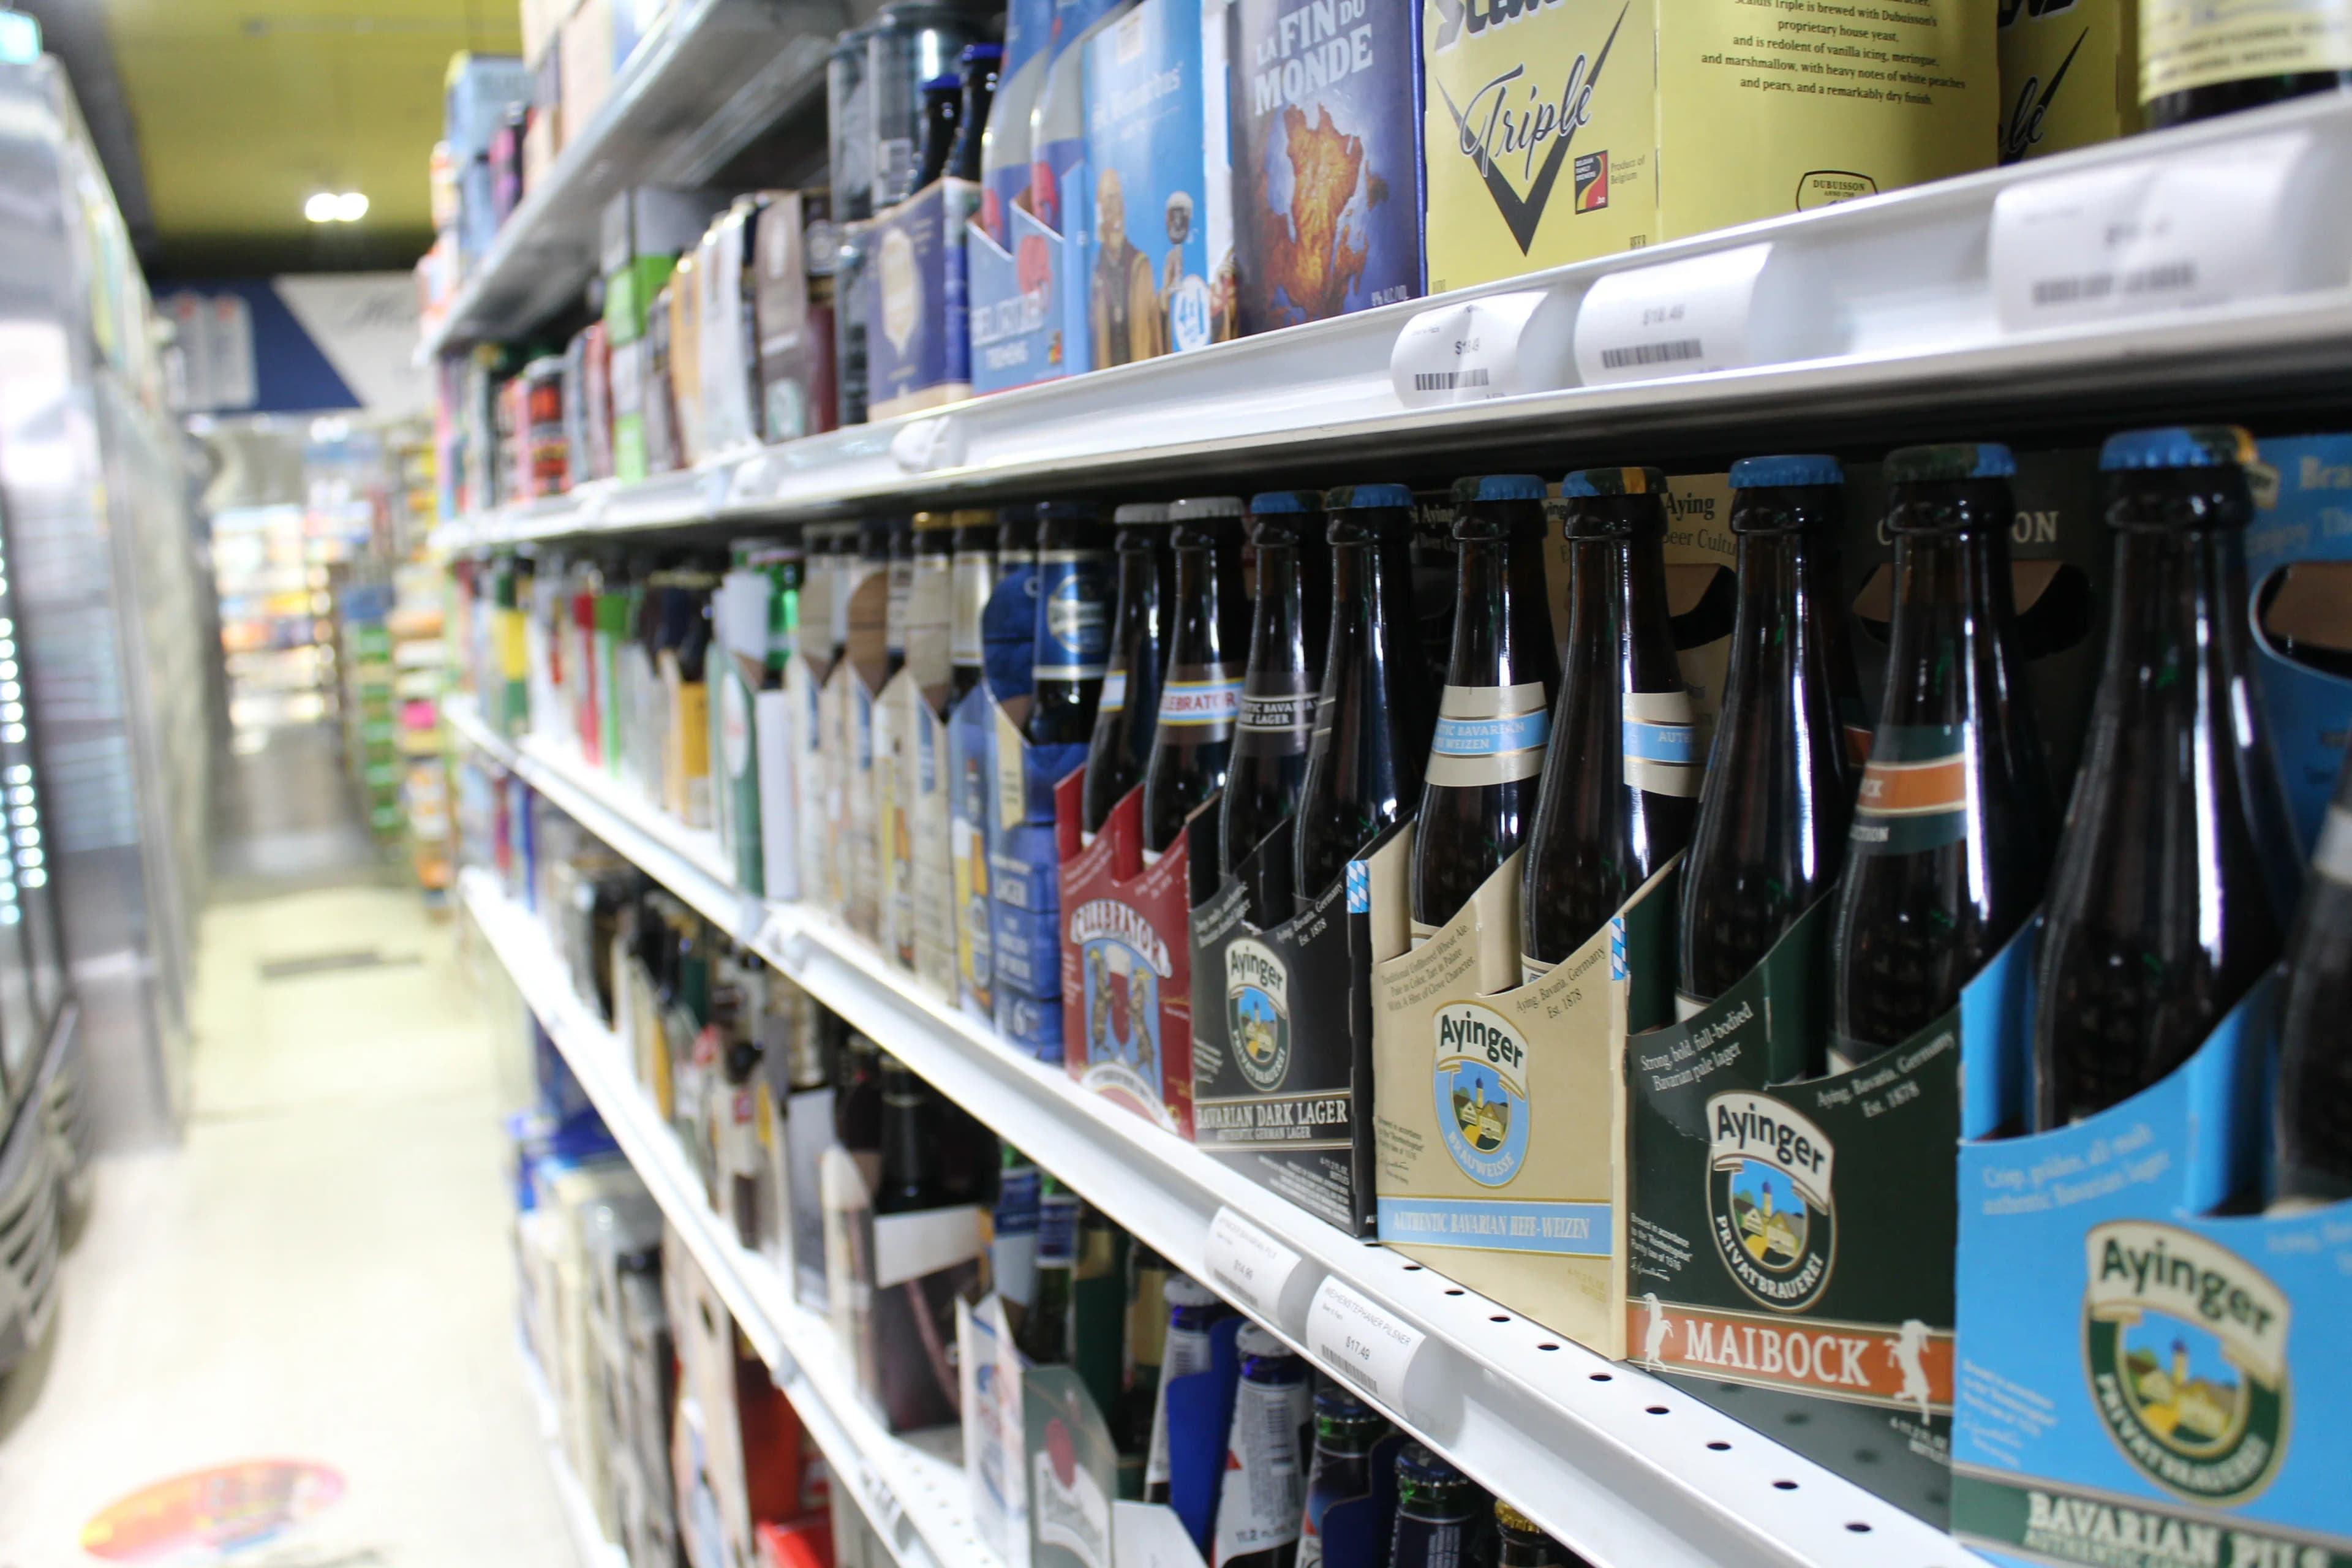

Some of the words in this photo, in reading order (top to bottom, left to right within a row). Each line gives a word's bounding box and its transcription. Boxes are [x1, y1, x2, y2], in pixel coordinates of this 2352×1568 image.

[1776, 0, 1804, 12] Triple
[1807, 2, 1815, 12] is
[1817, 2, 1855, 17] brewed
[1858, 8, 1880, 20] with
[1882, 10, 1937, 28] Dubuisson's
[1777, 20, 1836, 37] proprietary
[1839, 25, 1868, 38] house
[1256, 37, 1277, 66] LA
[1278, 0, 1343, 58] FIN
[1339, 0, 1365, 26] DU
[1733, 36, 1753, 47] and
[1756, 37, 1764, 48] is
[1767, 39, 1811, 53] redolent
[1814, 43, 1825, 54] of
[1827, 46, 1860, 58] vanilla
[1863, 48, 1889, 62] icing,
[1892, 53, 1939, 67] meringue,
[1255, 23, 1373, 117] MONDE
[1702, 53, 1722, 64] and
[1725, 56, 1798, 72] marshmallow,
[1801, 61, 1823, 74] with
[1826, 64, 1855, 80] heavy
[1858, 69, 1885, 80] notes
[1887, 70, 1898, 81] of
[1900, 72, 1926, 85] white
[1929, 77, 1966, 89] peaches
[1740, 78, 1760, 88] and
[1763, 80, 1794, 92] pears,
[1797, 83, 1816, 94] and
[1827, 86, 1883, 103] remarkably
[1887, 91, 1902, 104] dry
[1460, 53, 1591, 181] Triple
[1610, 160, 1636, 172] Product
[1637, 154, 1646, 165] of
[1610, 172, 1638, 185] Belgium
[1812, 179, 1866, 192] DUBUISSON
[1666, 492, 1715, 521] Aying
[1697, 529, 1737, 556] Cultu
[1256, 714, 1290, 725] LAGER
[1457, 722, 1525, 736] BAVARIAN
[1446, 739, 1490, 750] WEIZEN
[1314, 881, 1343, 913] Germany
[1231, 946, 1283, 992] Ayinger
[1567, 945, 1606, 981] Germany
[1547, 1005, 1562, 1019] Est.
[1561, 987, 1583, 1010] 1878
[1440, 1011, 1524, 1069] Ayinger
[1640, 1054, 1679, 1072] Strong,
[1669, 1039, 1697, 1063] bold,
[1693, 1000, 1754, 1051] full-bodied
[1896, 1029, 1956, 1074] Germany
[1651, 1069, 1695, 1091] Bavarian
[1692, 1057, 1714, 1083] pale
[1711, 1042, 1742, 1068] lager
[1885, 1079, 1921, 1109] 1878
[1196, 1105, 1254, 1129] BAVARIAN
[1256, 1103, 1294, 1127] DARK
[1297, 1100, 1348, 1125] LAGER
[1256, 1127, 1286, 1140] GERMAN
[1287, 1126, 1312, 1139] LAGER
[1717, 1103, 1826, 1175] Ayinger
[1447, 1131, 1515, 1178] BRAUWEISSE
[1393, 1211, 1449, 1232] AUTHENTIC
[1450, 1213, 1507, 1235] BAVARIAN
[1716, 1213, 1825, 1300] PRIVATBRAUEREI
[2100, 1237, 2275, 1335] Ayinger
[1345, 1335, 1371, 1361] $17.49
[1382, 1322, 1412, 1347] PILSNER
[1684, 1319, 1871, 1388] MAIBOCK
[2027, 1491, 2220, 1568] BAVARIAN
